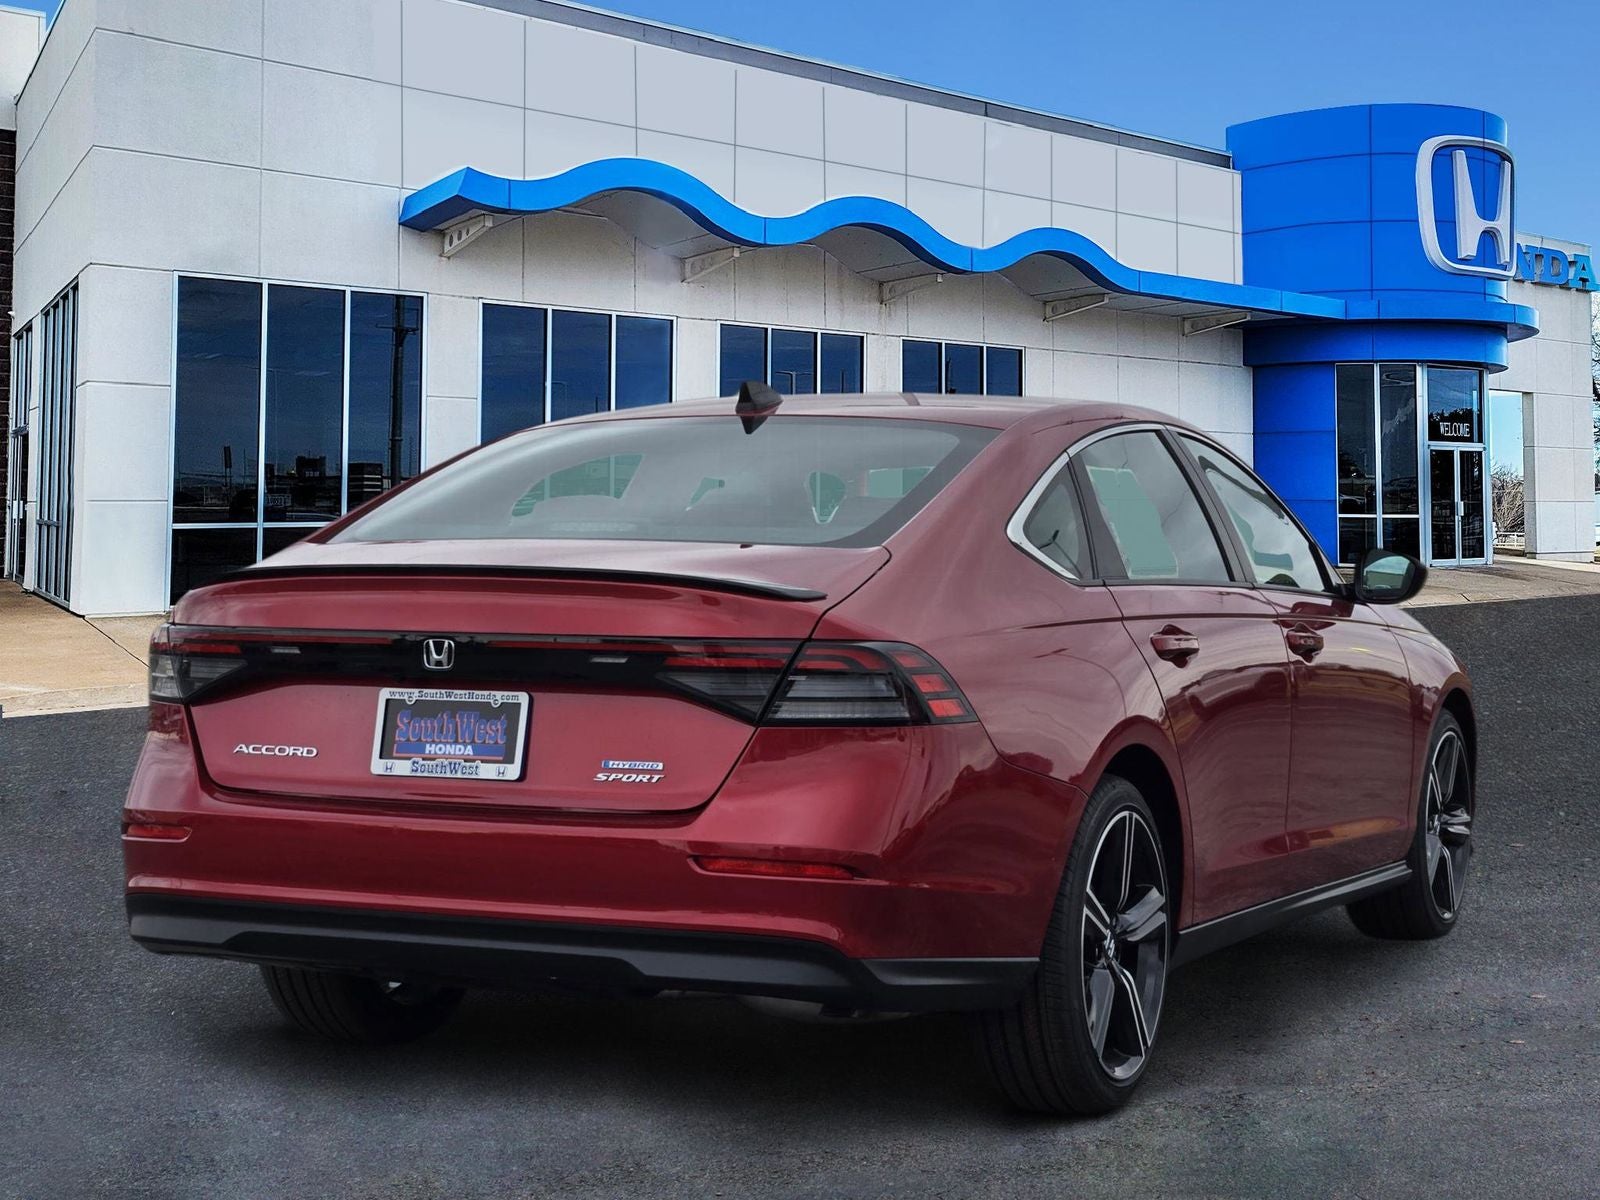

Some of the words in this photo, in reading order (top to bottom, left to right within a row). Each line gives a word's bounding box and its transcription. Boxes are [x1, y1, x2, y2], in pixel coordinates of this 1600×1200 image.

[1439, 421, 1471, 437] WELCOME
[395, 709, 508, 744] SouthWest
[232, 743, 318, 758] ACCORD
[425, 743, 474, 756] HONDA
[411, 760, 481, 776] SouthWest
[611, 761, 660, 770] HYBRID
[593, 772, 665, 783] SPORT
